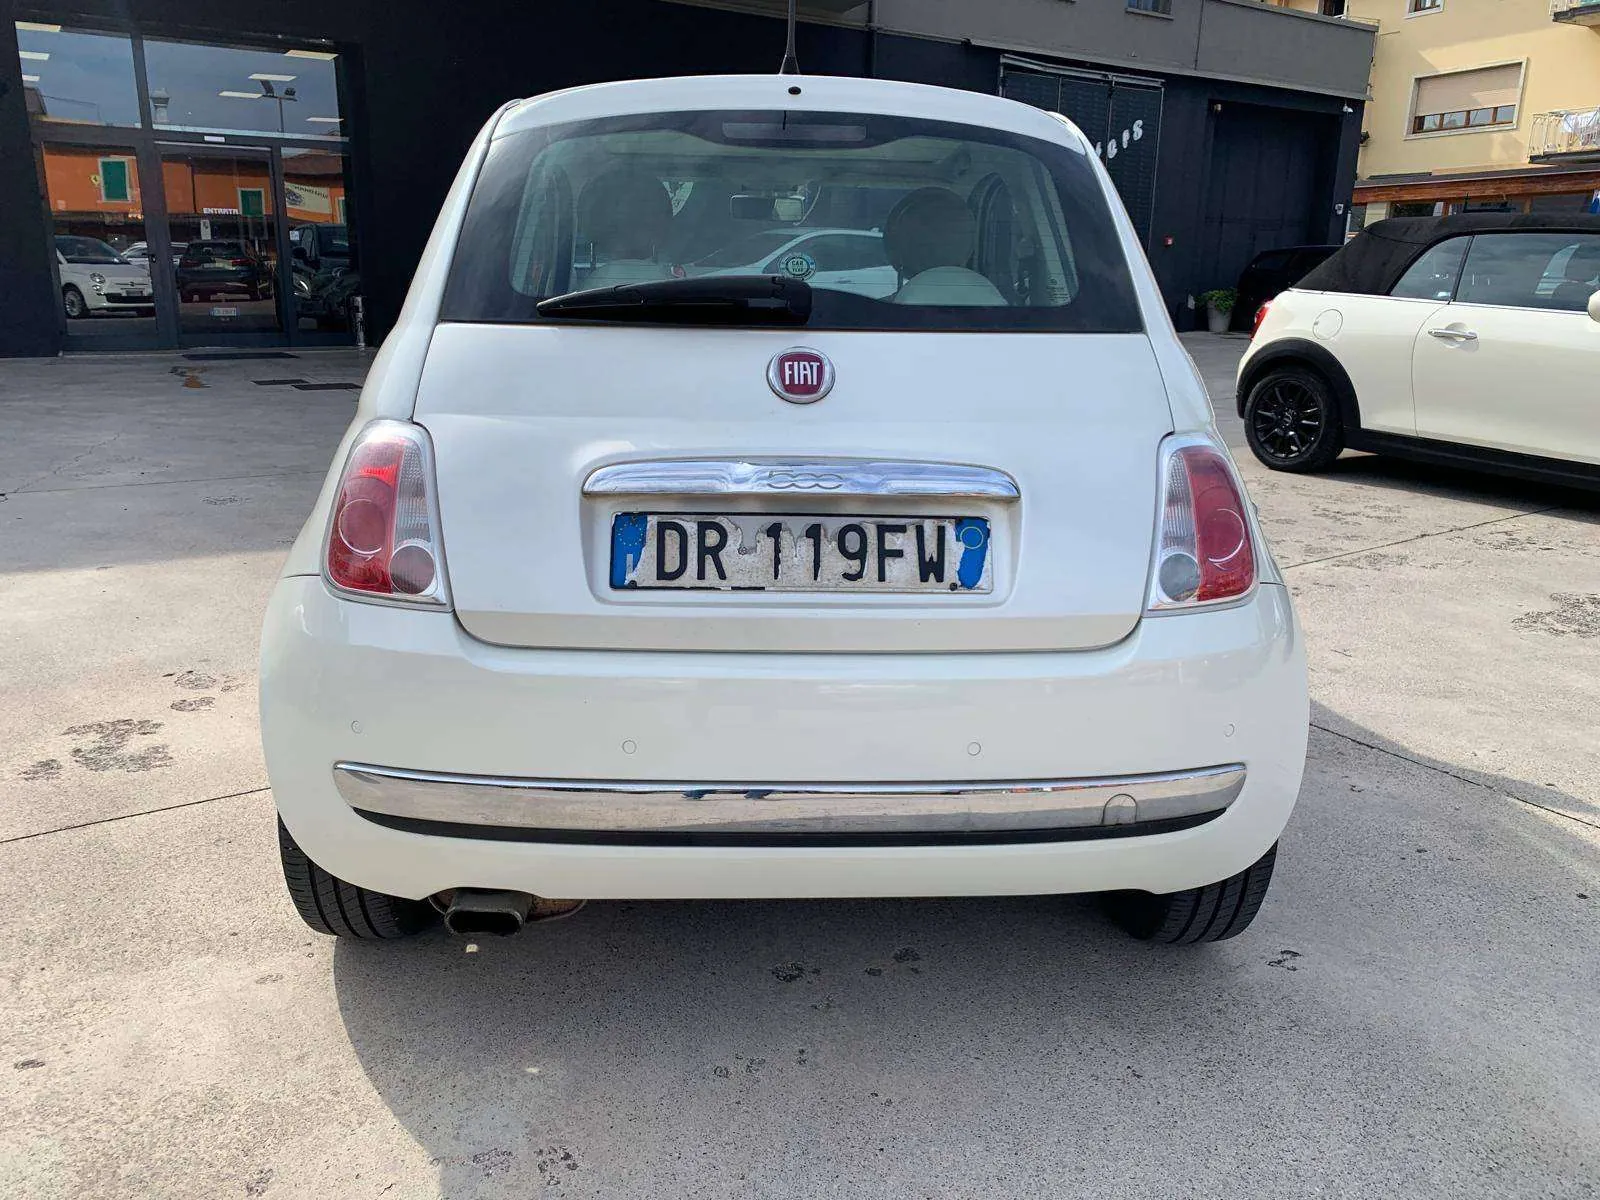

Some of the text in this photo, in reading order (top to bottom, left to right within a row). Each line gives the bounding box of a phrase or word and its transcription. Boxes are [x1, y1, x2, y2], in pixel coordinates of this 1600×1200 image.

[203, 207, 239, 215] ENTRATA
[784, 361, 820, 385] FIAT
[766, 469, 843, 490] 500
[656, 520, 946, 583] DR 119FW
